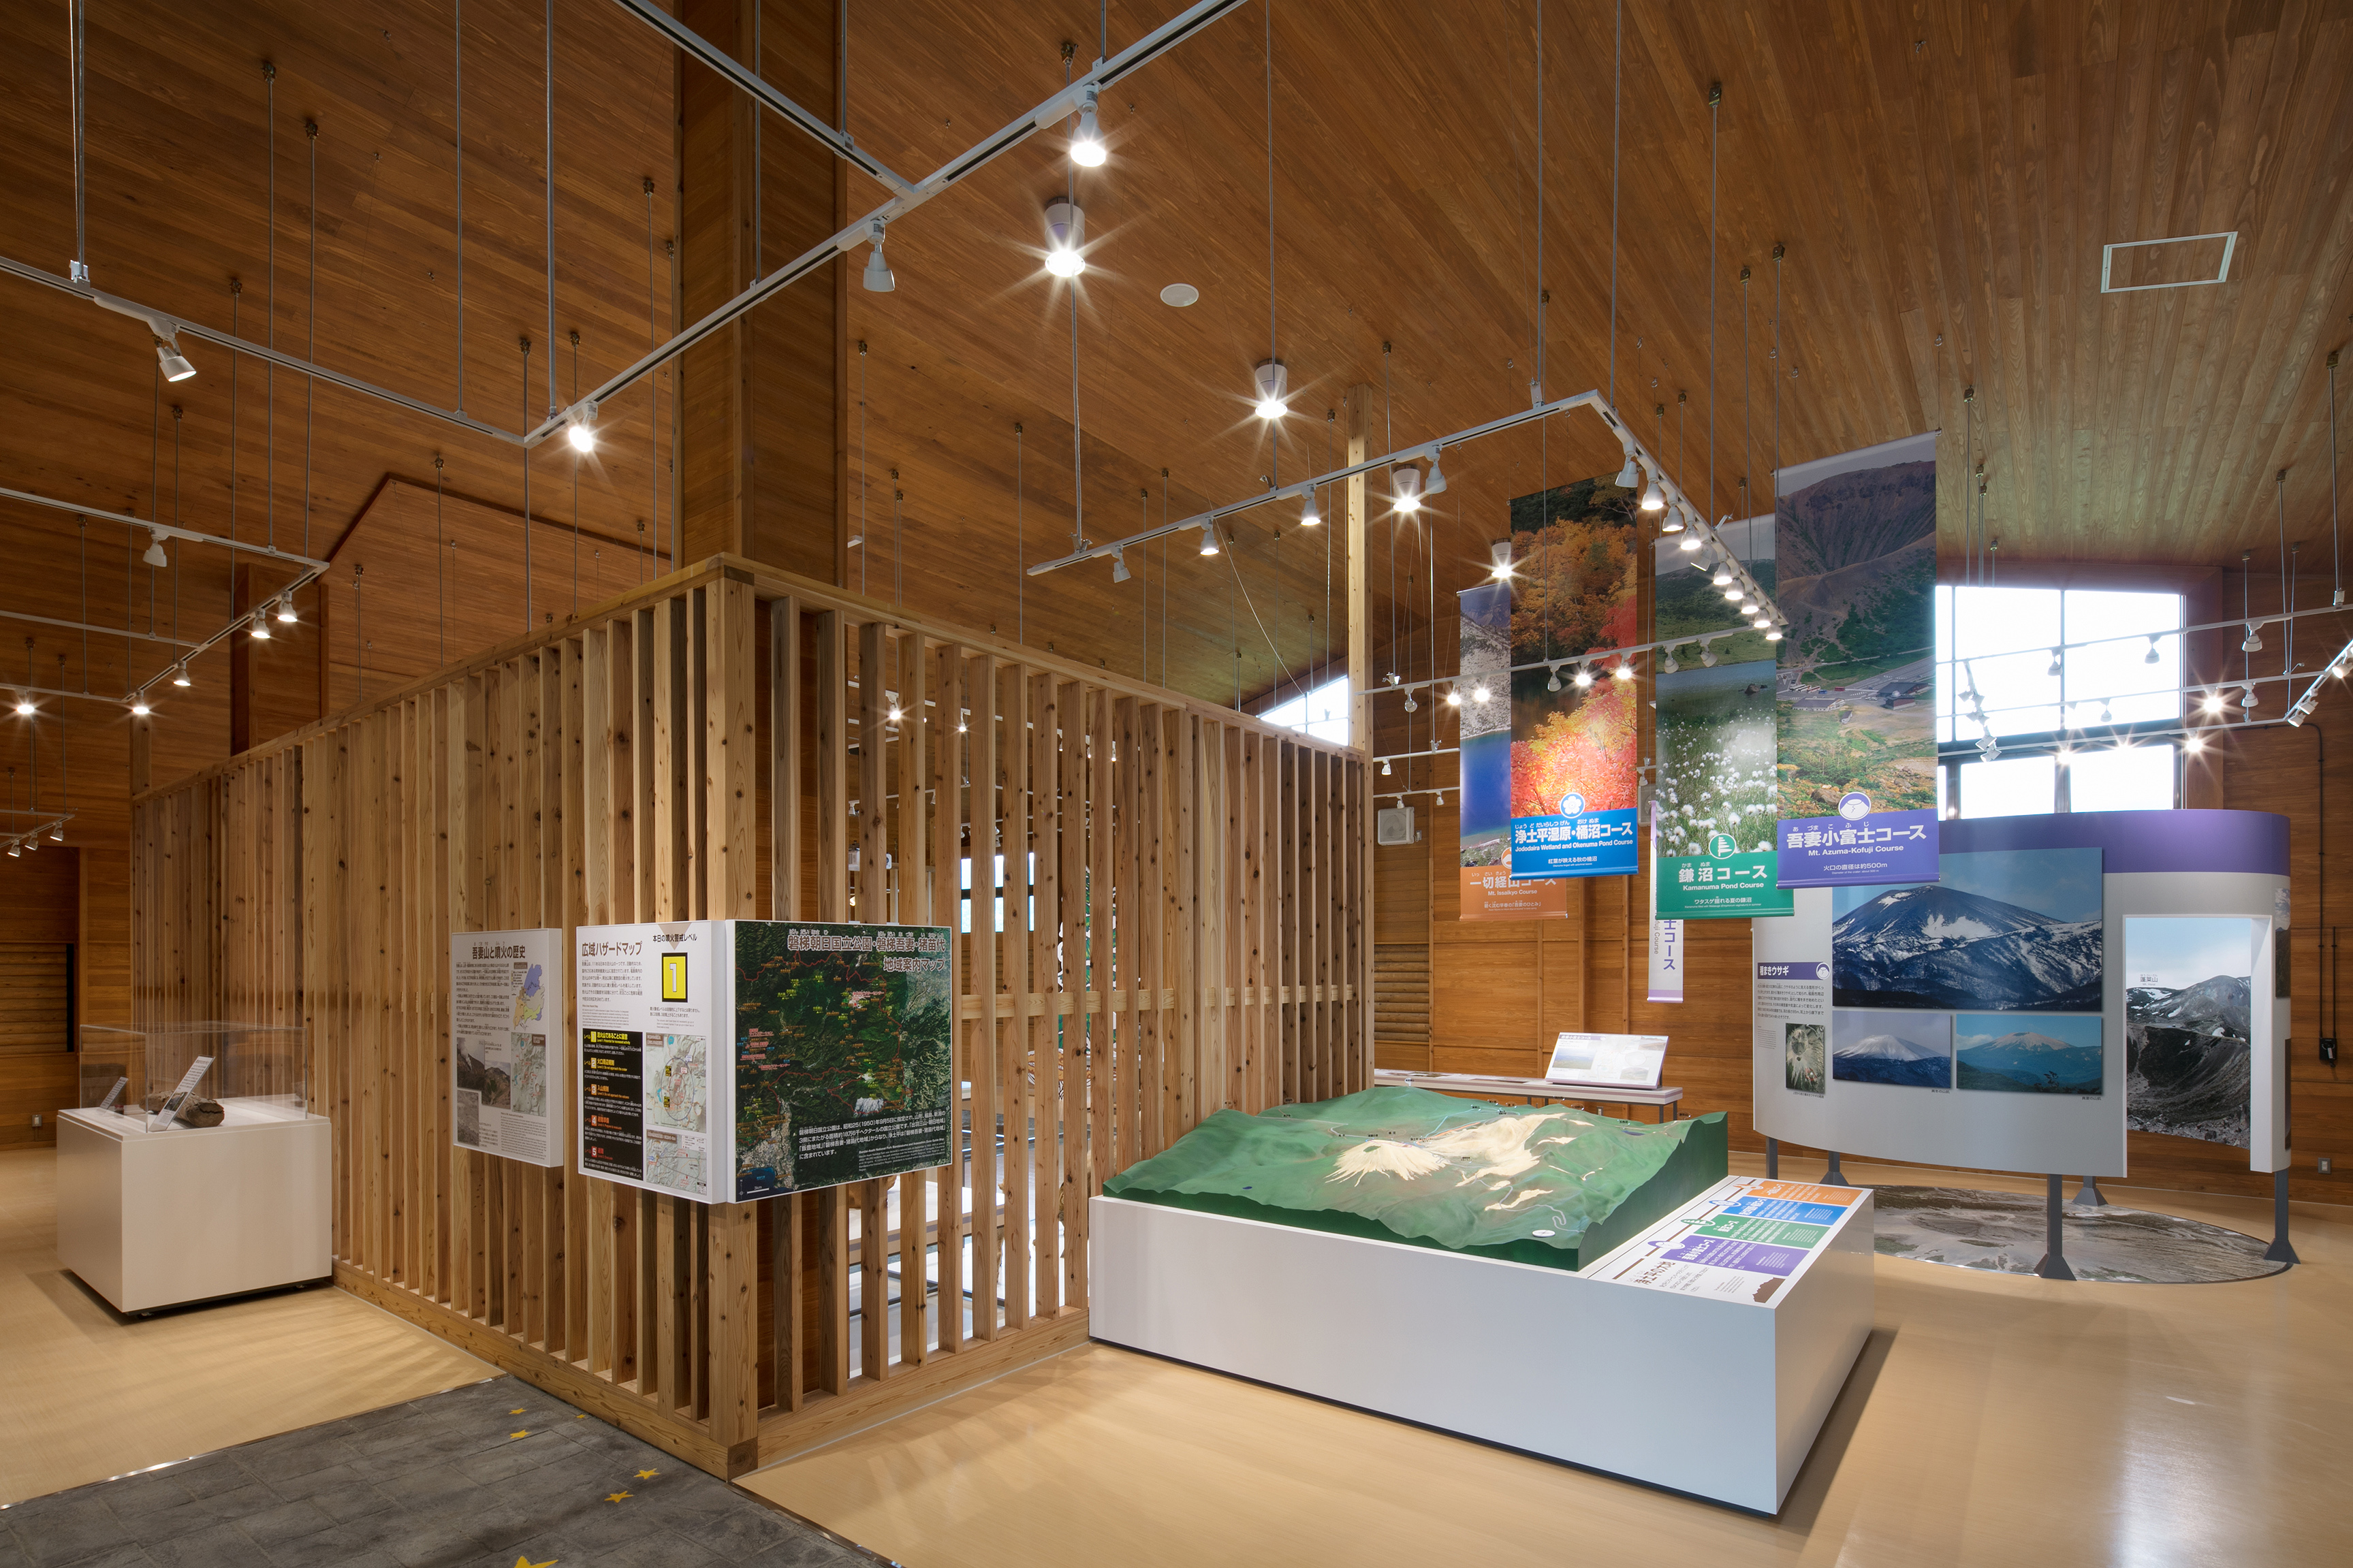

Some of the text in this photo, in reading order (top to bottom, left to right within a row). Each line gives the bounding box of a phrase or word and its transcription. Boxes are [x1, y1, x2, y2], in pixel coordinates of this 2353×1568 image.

[1515, 822, 1632, 844] 浄土平湿原・桶沼コース
[1787, 825, 1927, 848] 吾妻小富士コース
[1822, 846, 1874, 855] Azuma-Kofuji
[1548, 856, 1597, 864] 紅葉が映える秋の桶沼
[1823, 863, 1887, 871] 火口の直径は約500m
[1678, 865, 1767, 883] 鎌沼コース
[652, 933, 697, 942] 本日の噴火警戒レベル
[787, 935, 945, 952] 磐梯朝日国立公園・磐梯吾妻・猪苗代
[472, 945, 526, 960] 吾妻山と噴火の歴史
[582, 941, 642, 957] 広域ハザードマップ
[883, 957, 945, 972] 地域案内マップ
[1760, 965, 1789, 976] 種まきウサギ
[669, 963, 677, 993] 1
[799, 1149, 837, 1160] に含まれています。
